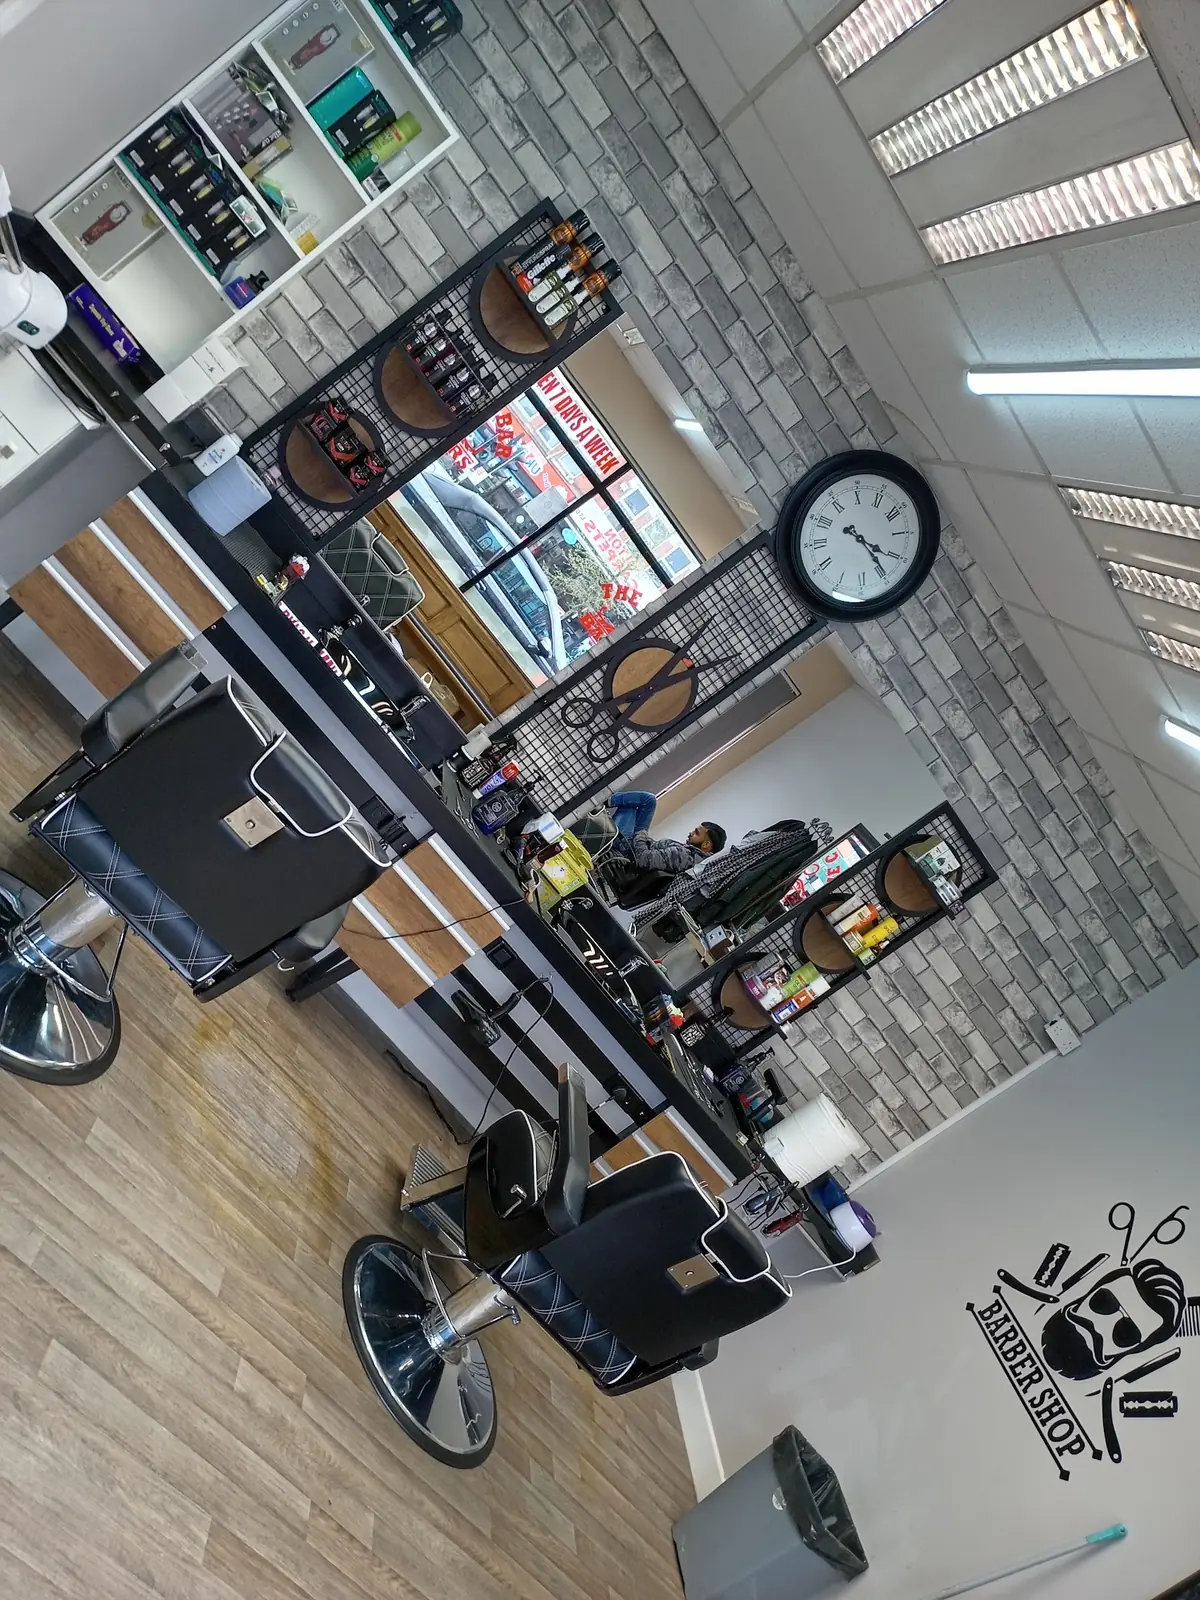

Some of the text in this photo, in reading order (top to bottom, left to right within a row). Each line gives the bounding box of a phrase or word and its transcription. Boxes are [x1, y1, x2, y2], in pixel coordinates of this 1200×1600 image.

[525, 252, 556, 280] Gillette
[549, 387, 565, 402] 7
[553, 394, 588, 432] DAYS
[494, 411, 514, 457] BAR
[576, 425, 592, 441] A
[582, 433, 619, 474] WEEK
[884, 506, 900, 522] XII
[977, 1299, 1086, 1457] BARBER SHOP
